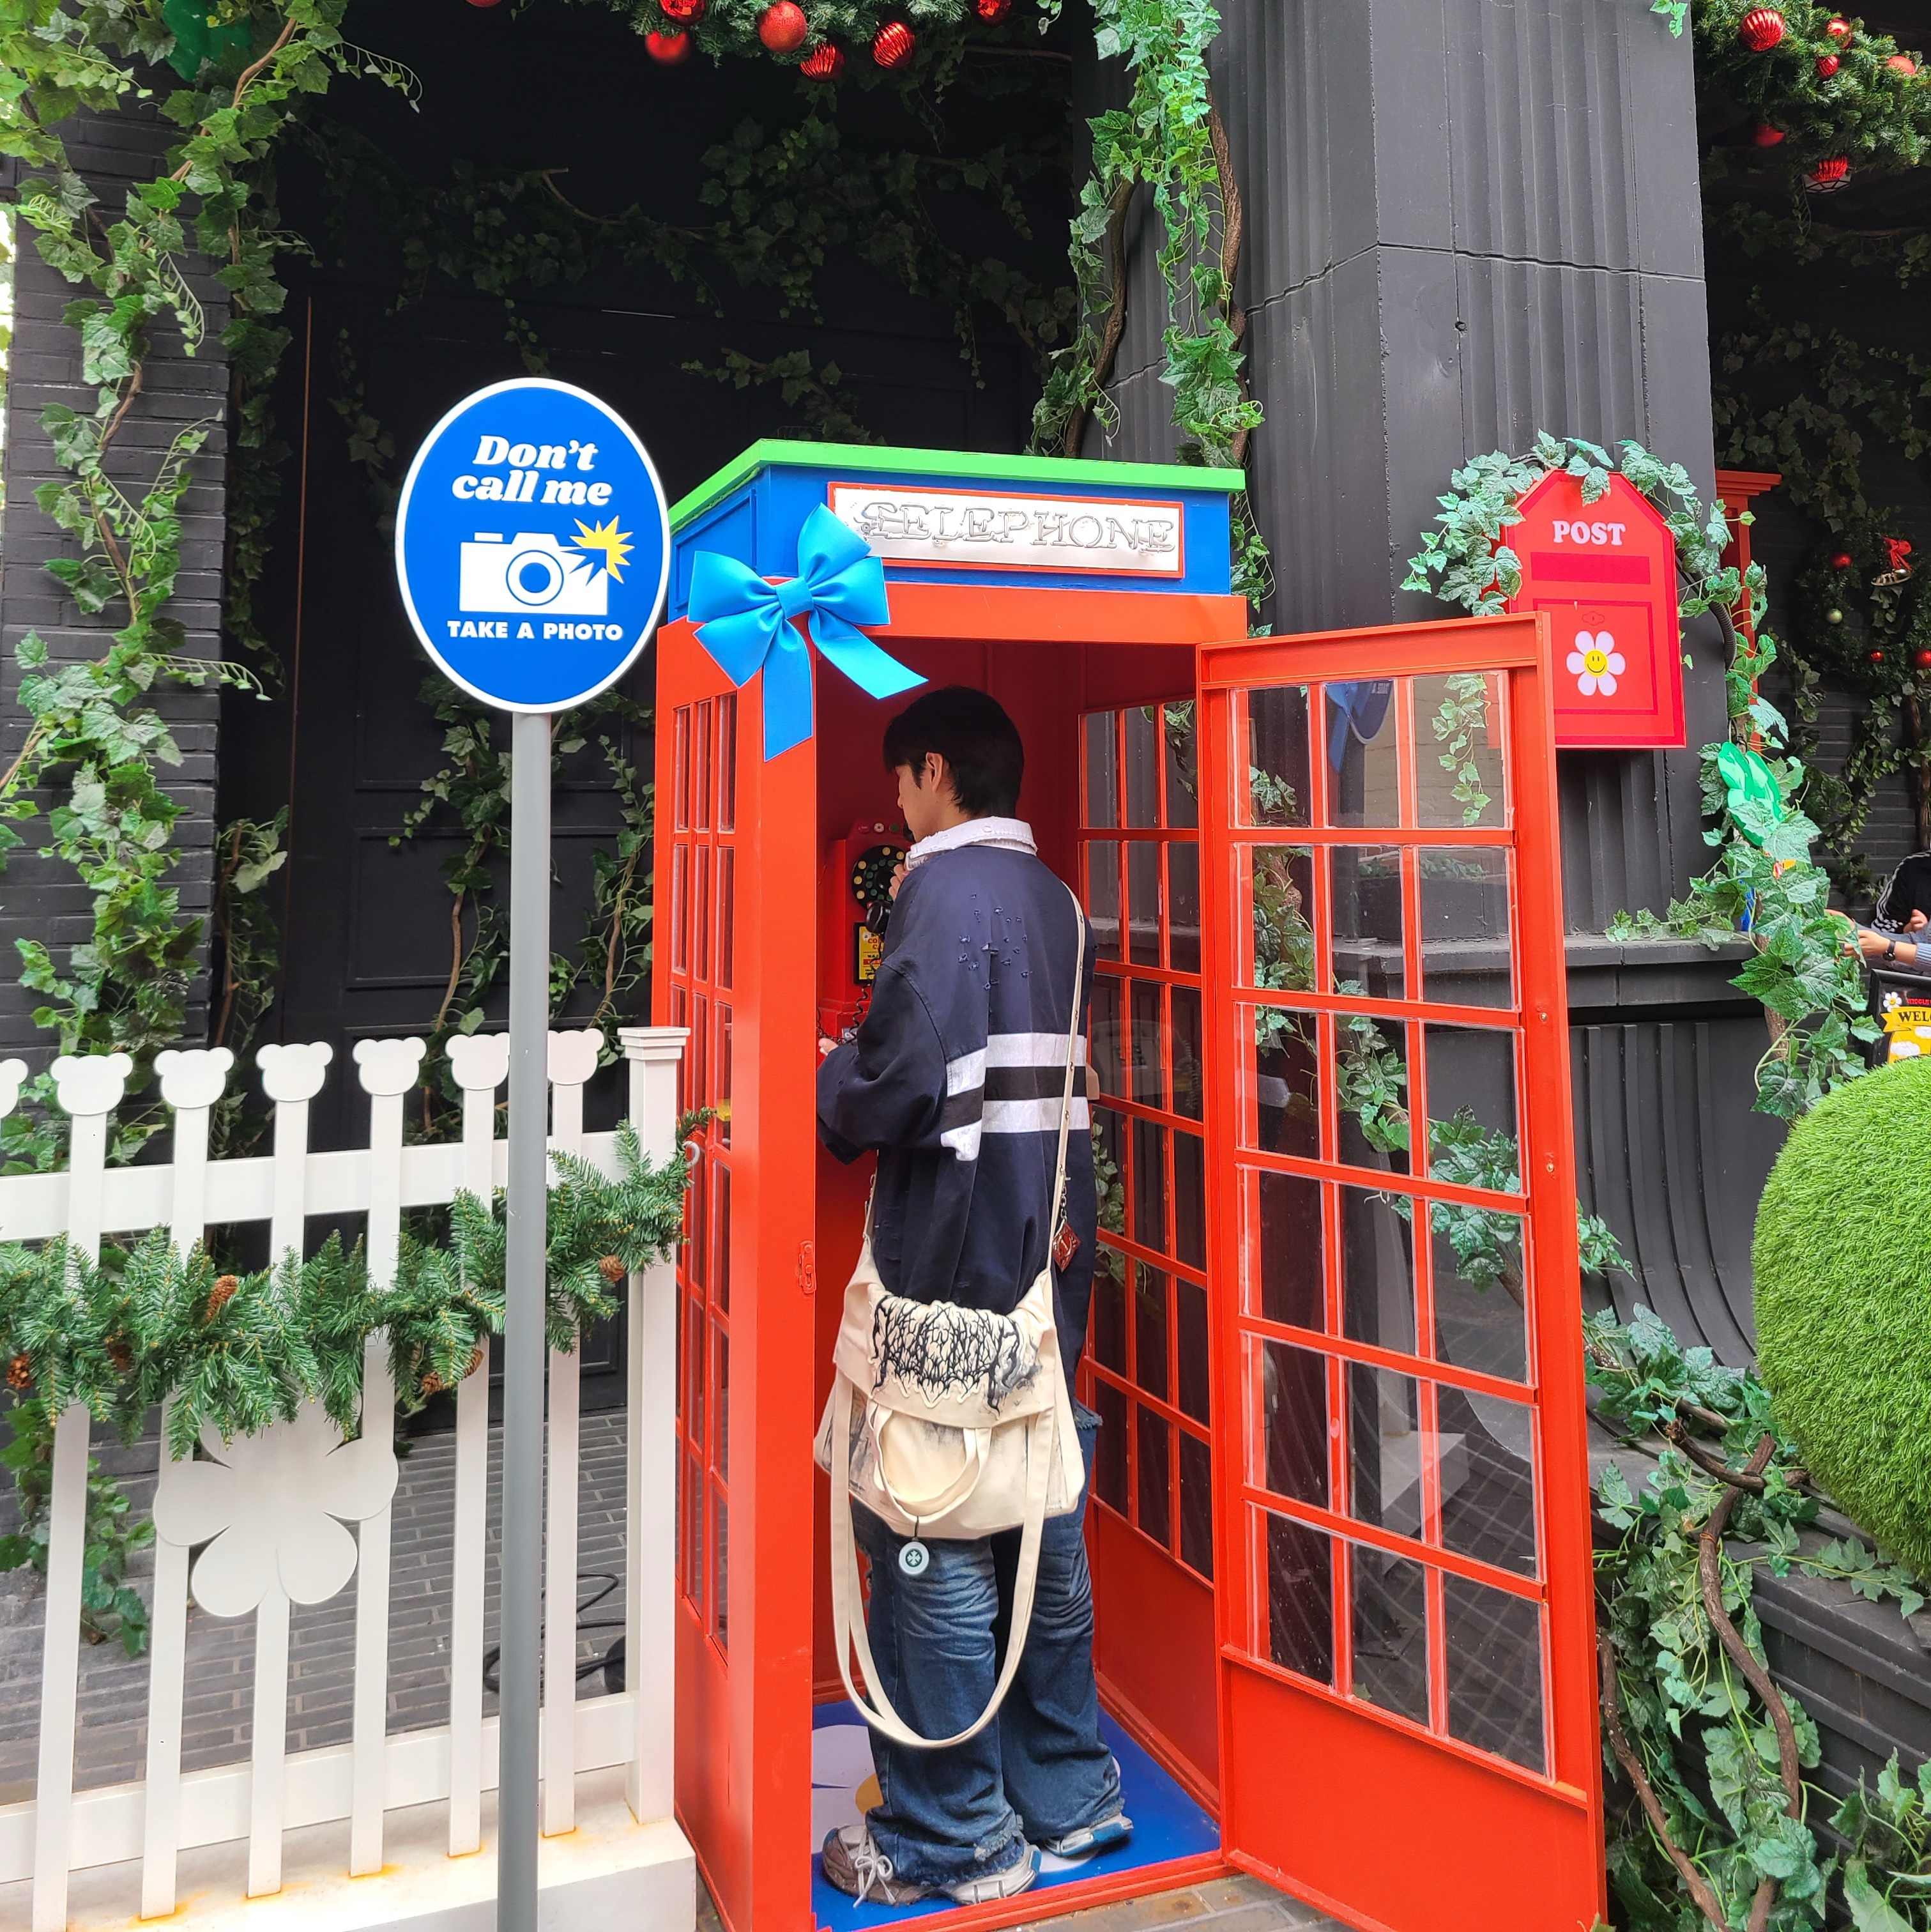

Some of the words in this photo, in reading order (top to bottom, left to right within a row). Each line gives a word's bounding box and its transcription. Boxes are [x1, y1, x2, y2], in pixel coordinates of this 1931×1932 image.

[472, 435, 599, 471] Don't
[452, 469, 539, 503] call
[540, 480, 613, 506] me
[1552, 520, 1626, 546] POST
[447, 620, 508, 638] TAKE
[516, 622, 535, 639] A
[543, 622, 623, 641] PHOTO
[1898, 1011, 1931, 1022] WEL
